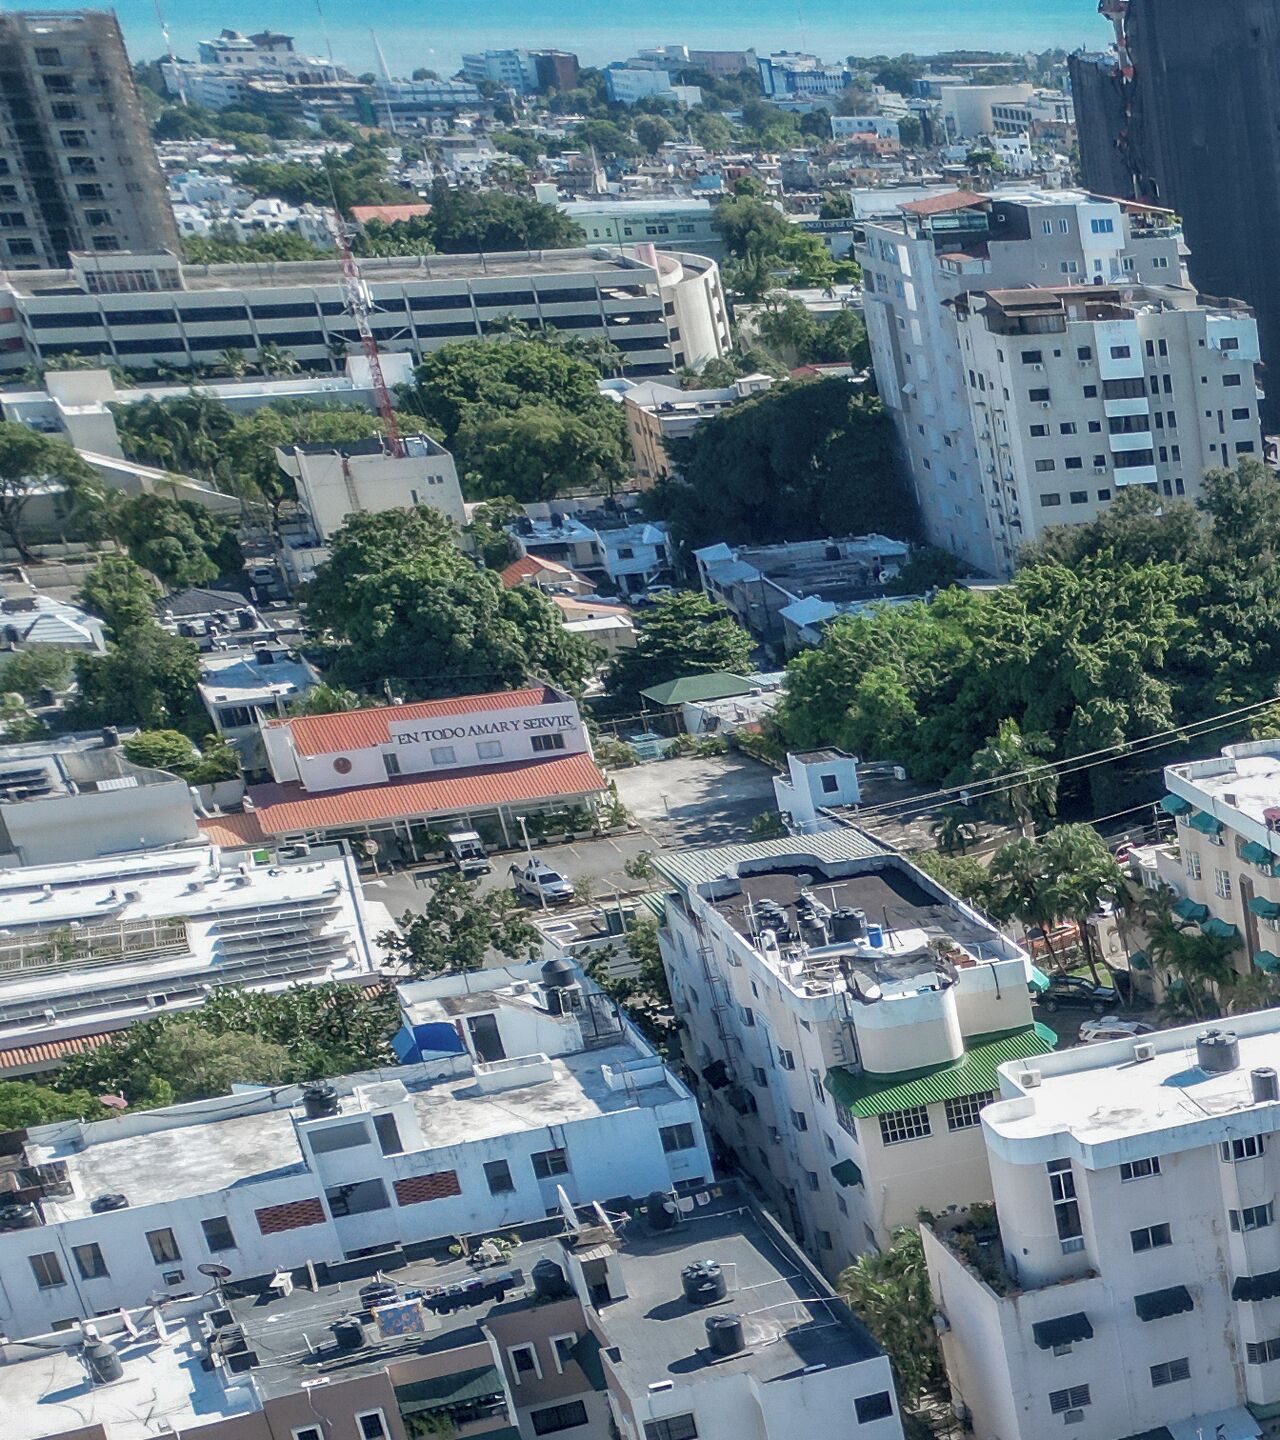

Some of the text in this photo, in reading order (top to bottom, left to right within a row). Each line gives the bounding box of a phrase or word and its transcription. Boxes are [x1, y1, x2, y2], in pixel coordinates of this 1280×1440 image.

[421, 729, 466, 742] TODO
[468, 723, 510, 737] AMAR
[509, 721, 520, 731] Y
